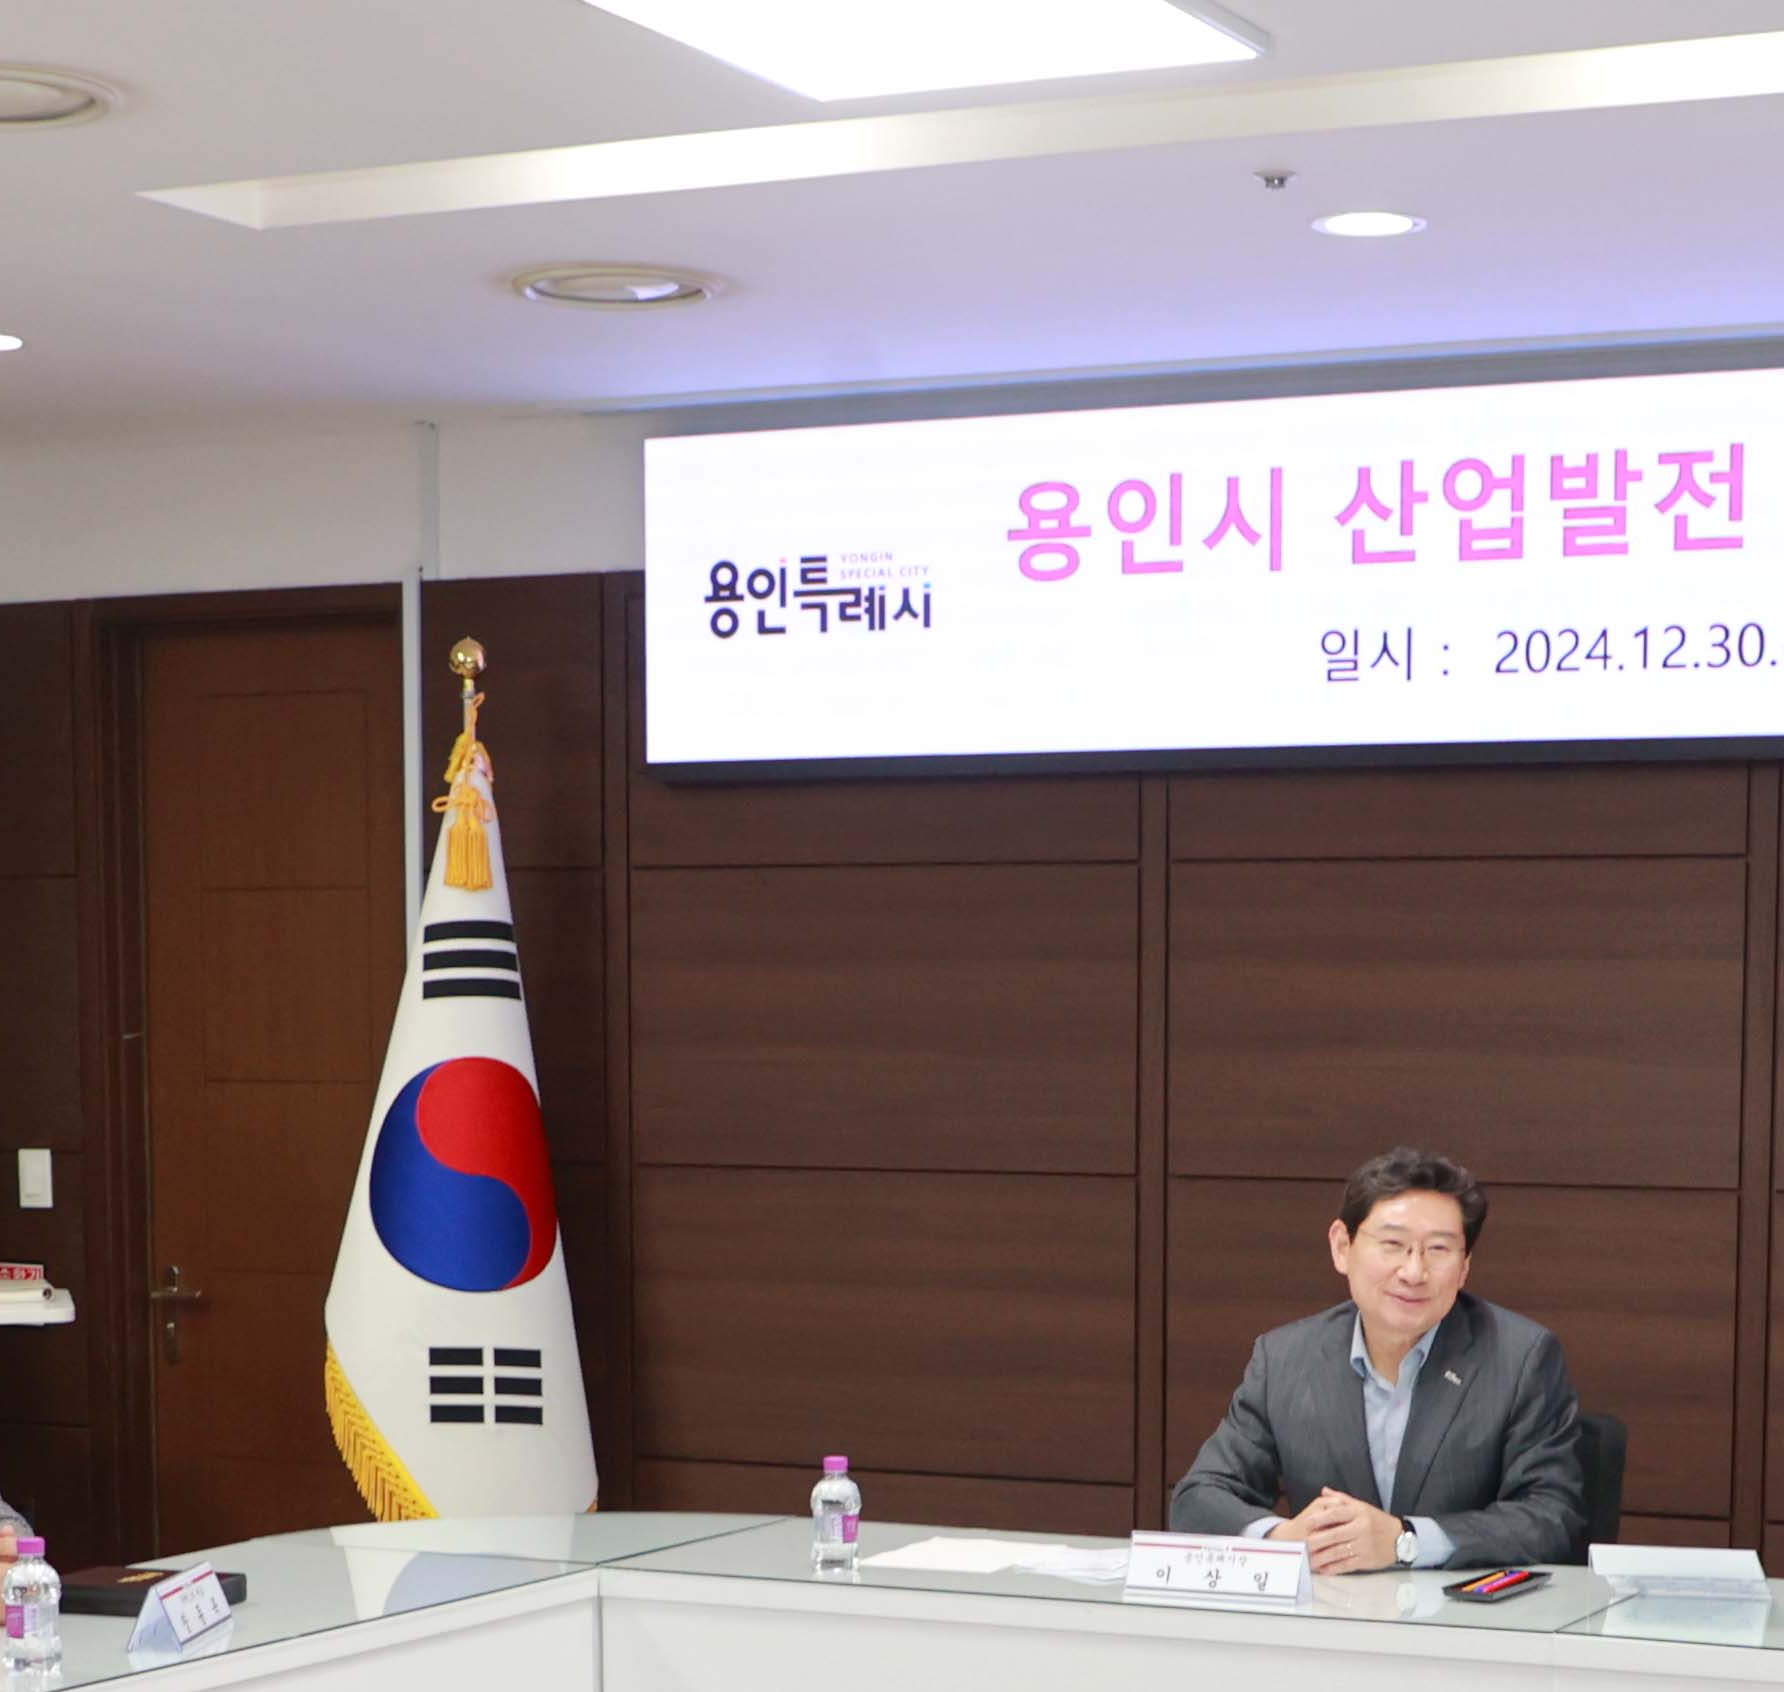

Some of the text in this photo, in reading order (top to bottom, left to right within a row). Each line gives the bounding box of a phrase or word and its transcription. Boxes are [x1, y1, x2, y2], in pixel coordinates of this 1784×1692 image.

[1007, 468, 1282, 581] 용인시
[1336, 443, 1744, 564] 산업발전
[840, 551, 894, 564] YONGIN
[840, 565, 930, 580] SPECIAL CITY
[704, 555, 931, 639] 용인특례시
[1321, 627, 1412, 682] 일시
